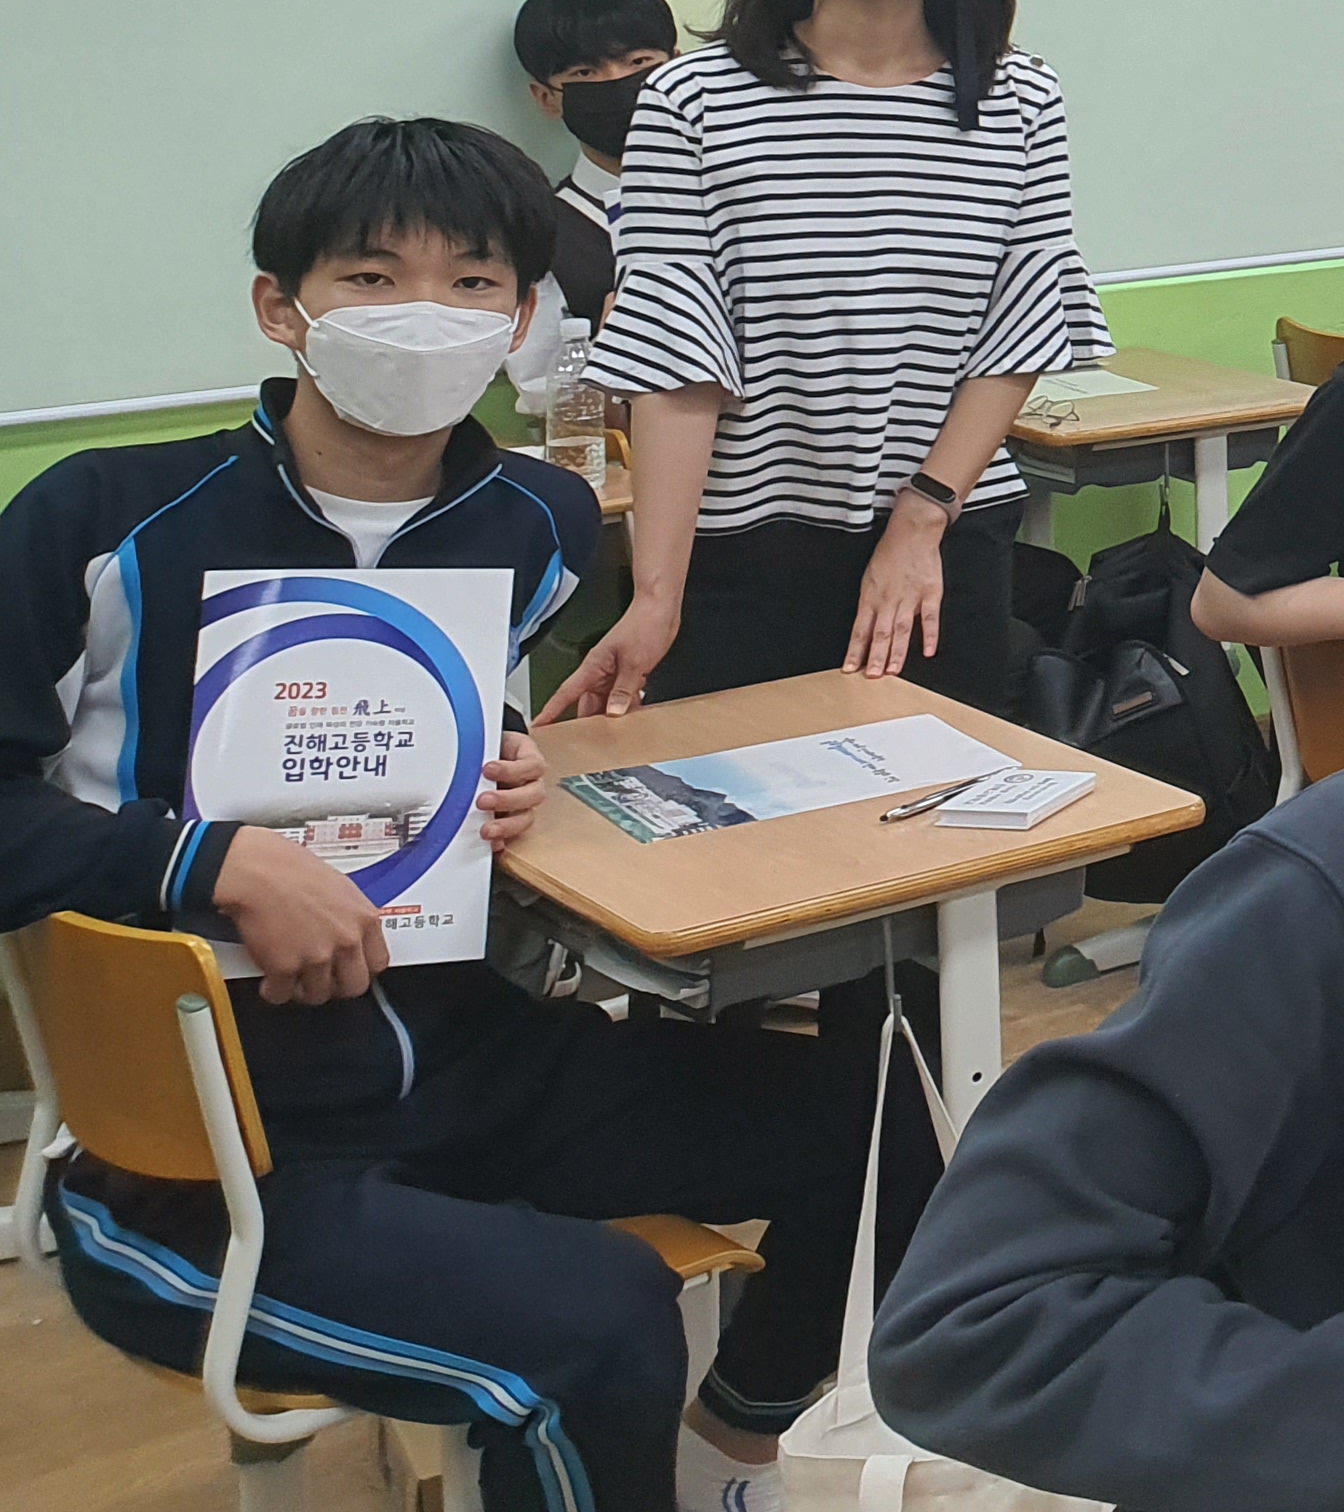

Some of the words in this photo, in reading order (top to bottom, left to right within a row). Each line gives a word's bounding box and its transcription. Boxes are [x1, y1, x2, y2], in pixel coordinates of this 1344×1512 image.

[274, 682, 328, 700] 2023
[284, 730, 415, 754] 진해고등학교
[282, 754, 388, 782] 입학안내
[379, 914, 454, 930] 해고등학교
